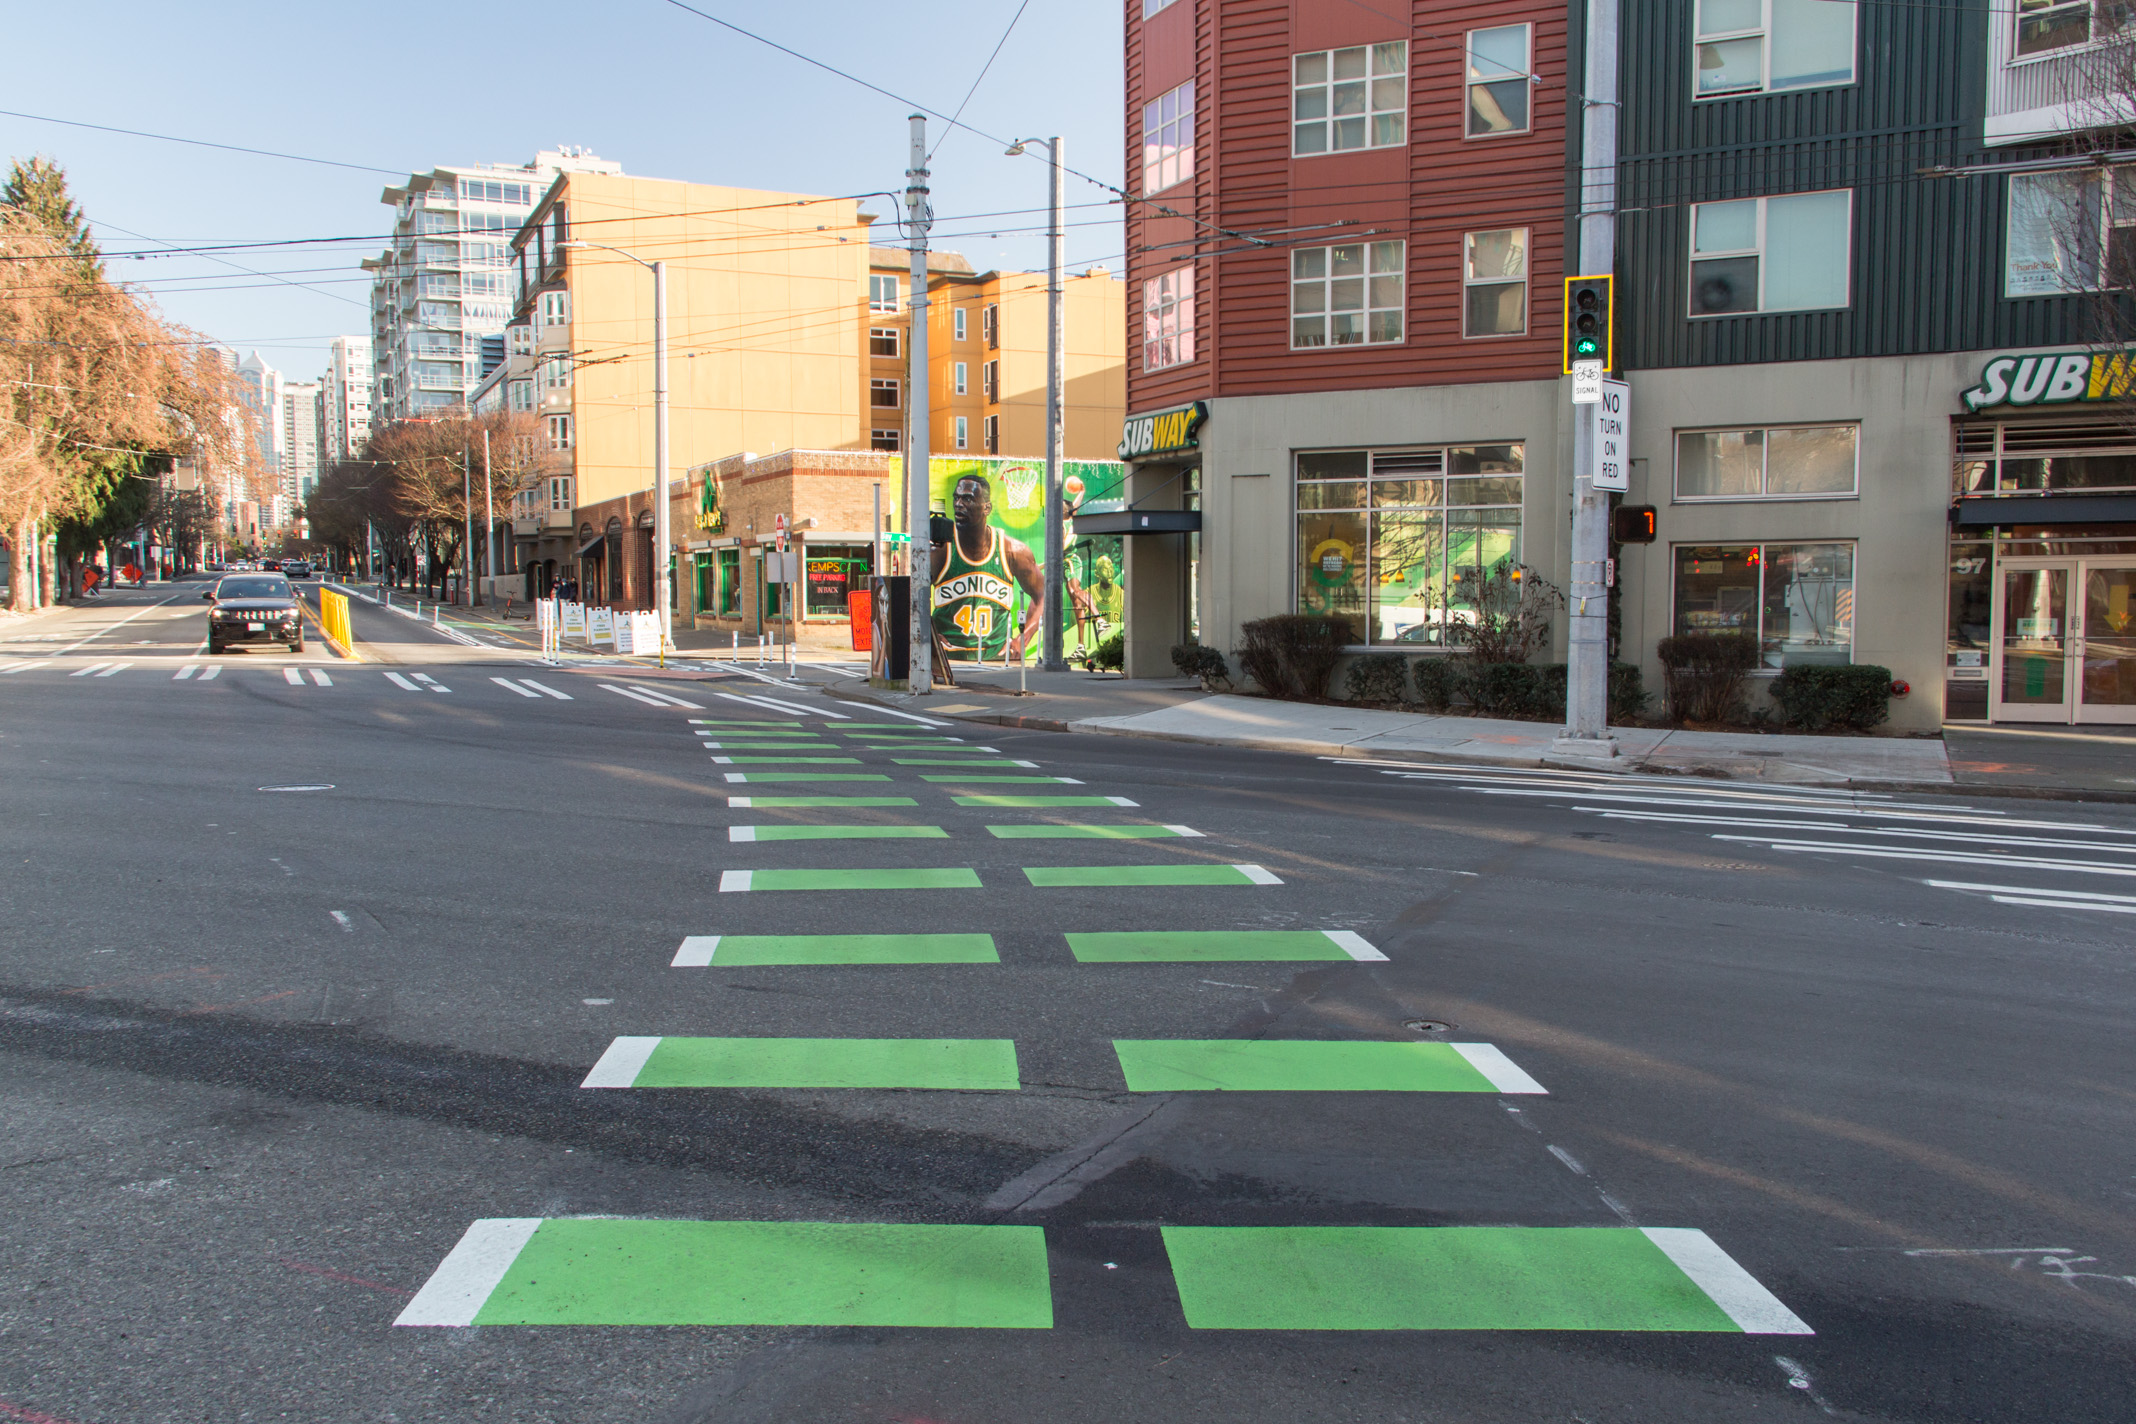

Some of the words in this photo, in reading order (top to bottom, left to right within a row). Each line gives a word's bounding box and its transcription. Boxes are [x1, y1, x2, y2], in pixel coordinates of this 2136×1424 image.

[2010, 262, 2040, 271] Thank
[2041, 260, 2058, 270] You
[1575, 386, 1599, 394] SIGNAL
[1965, 355, 2136, 408] SUBW
[1602, 393, 1620, 413] NO
[1117, 406, 1197, 457] SUBWAY
[1599, 418, 1622, 436] TURN
[1604, 440, 1616, 457] ON
[1602, 462, 1619, 478] RED
[1956, 557, 1987, 575] 97
[940, 576, 1008, 599] SONICS
[953, 604, 993, 637] 40
